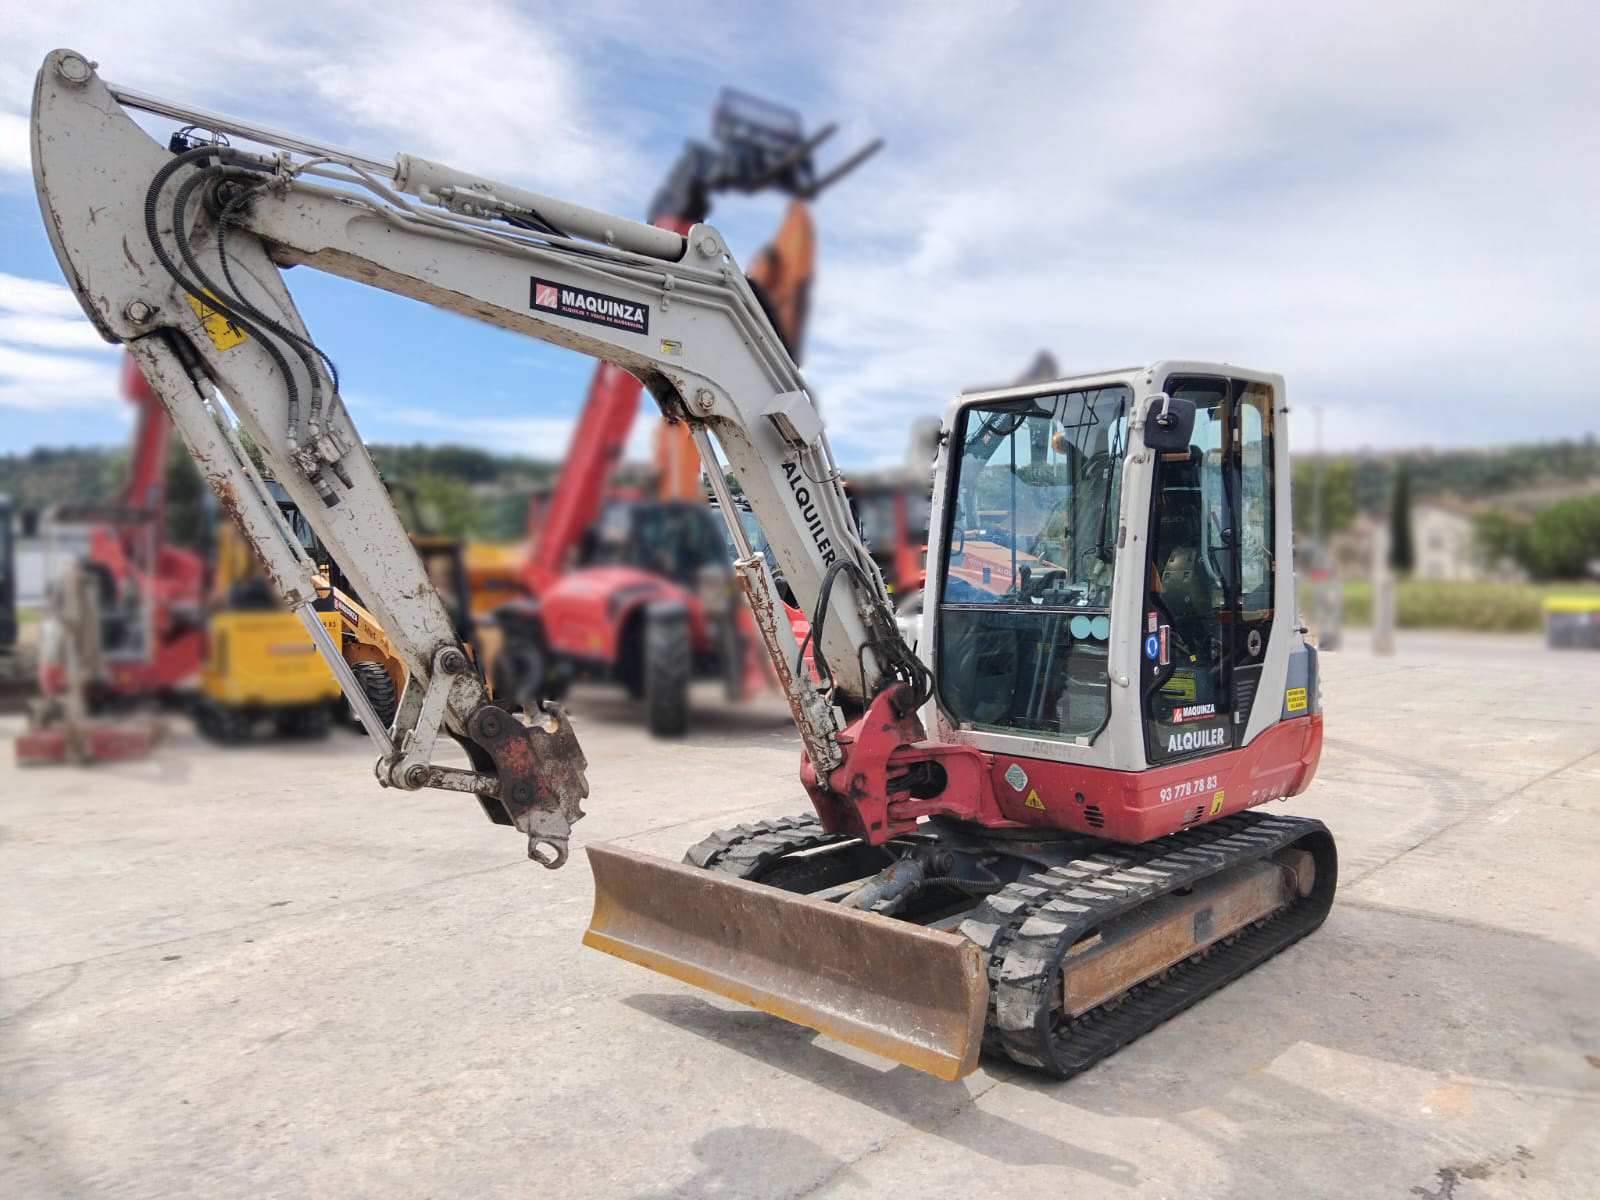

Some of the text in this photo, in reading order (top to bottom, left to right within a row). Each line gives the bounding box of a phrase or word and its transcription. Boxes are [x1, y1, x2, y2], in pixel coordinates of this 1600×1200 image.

[562, 290, 644, 323] MAQUINZA
[781, 462, 836, 568] ALQUILER
[1183, 703, 1215, 717] MAQUINZA
[1168, 727, 1225, 753] ALQUILER
[1160, 775, 1217, 803] 93 778 78 83
